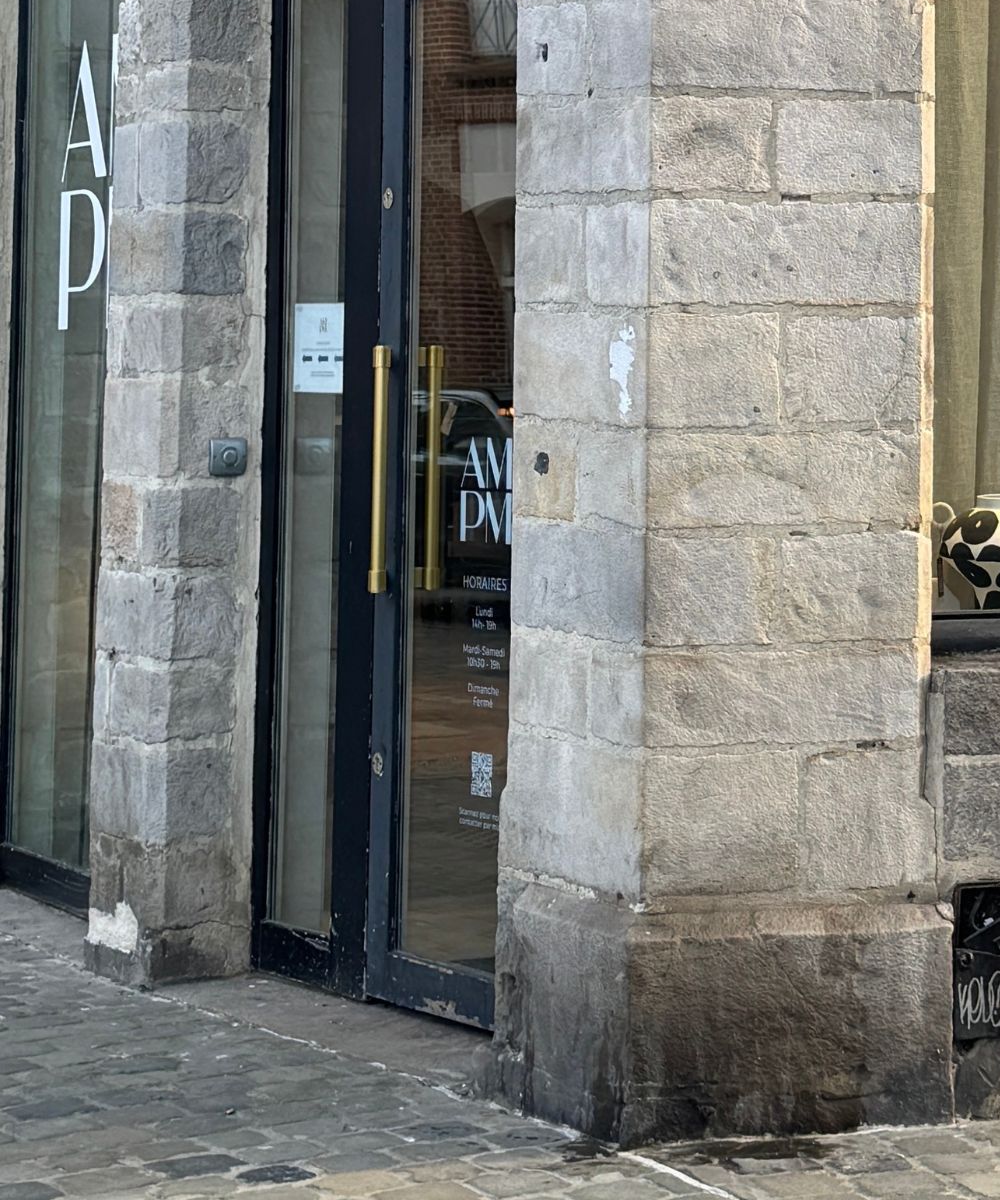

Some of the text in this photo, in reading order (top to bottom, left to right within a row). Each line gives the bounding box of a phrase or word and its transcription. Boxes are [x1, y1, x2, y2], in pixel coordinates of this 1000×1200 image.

[61, 33, 119, 183] A
[57, 185, 114, 331] P
[460, 436, 512, 490] AM
[460, 490, 512, 545] PM
[462, 575, 508, 591] HORAIRES
[475, 605, 494, 618] Lundi
[467, 682, 500, 696] Dimanche
